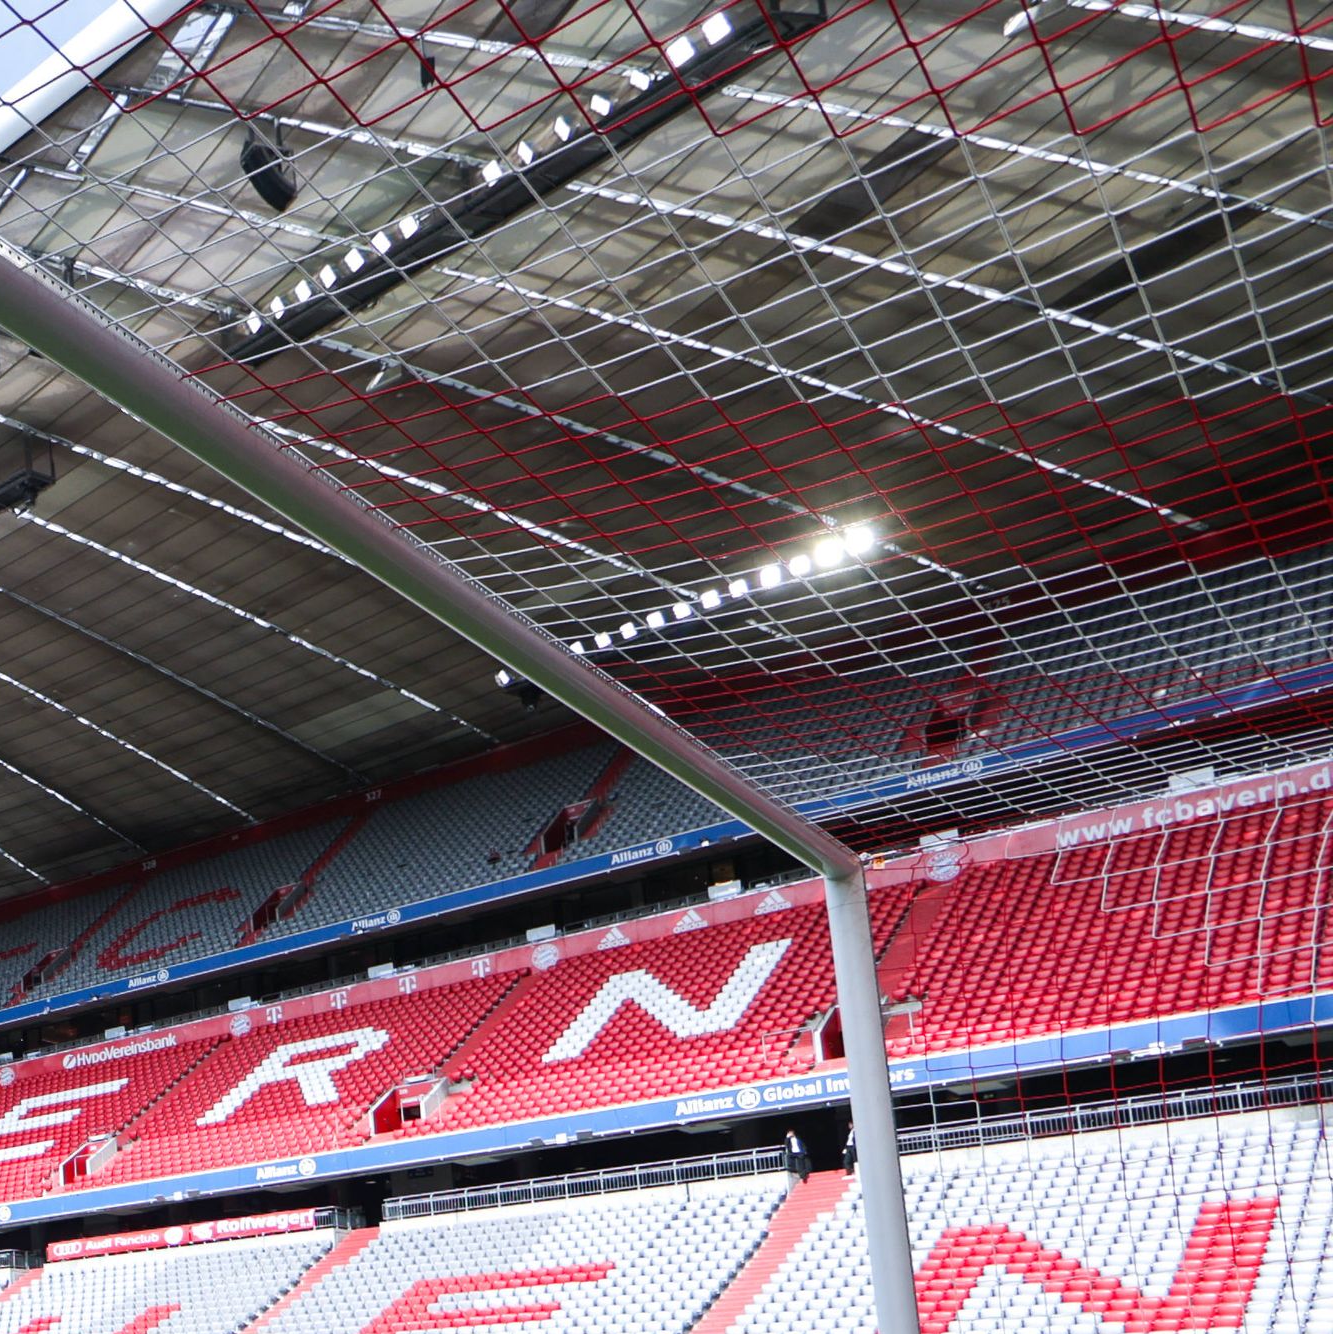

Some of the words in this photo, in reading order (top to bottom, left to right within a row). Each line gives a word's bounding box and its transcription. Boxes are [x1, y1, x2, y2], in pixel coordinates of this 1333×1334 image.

[906, 767, 960, 790] Allianz
[610, 846, 654, 866] Allianz
[351, 912, 386, 931] Allianz
[128, 974, 157, 989] Allianz
[76, 1033, 177, 1067] HypoVereinsbank
[675, 1096, 734, 1116] Allianz
[763, 1079, 822, 1103] Global
[256, 1164, 298, 1181] Allianz
[85, 1237, 113, 1251] Audi
[114, 1232, 159, 1247] Fanclub
